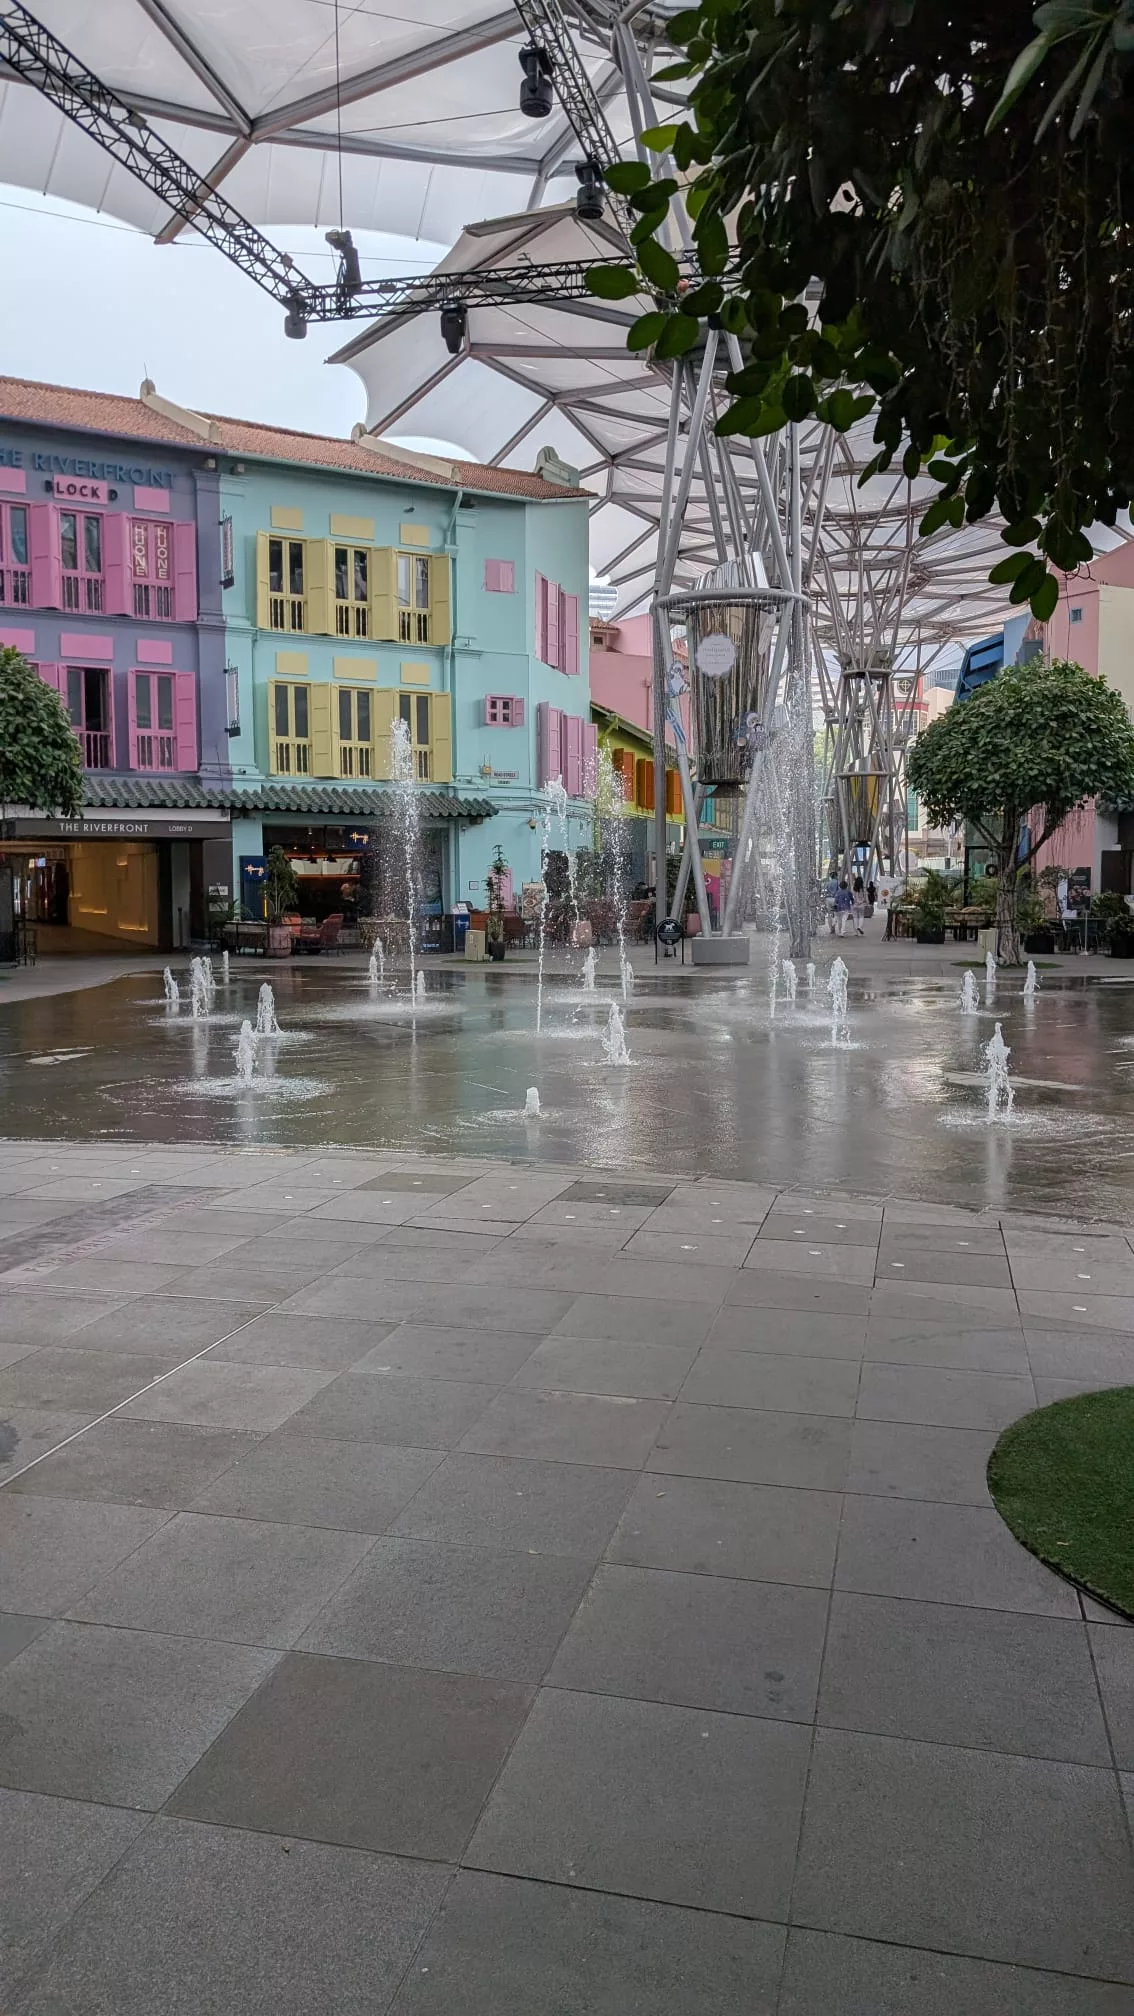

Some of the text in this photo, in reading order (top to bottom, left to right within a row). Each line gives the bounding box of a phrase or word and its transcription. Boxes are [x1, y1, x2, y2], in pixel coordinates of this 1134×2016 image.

[33, 453, 175, 489] RIVERFRONT
[45, 480, 119, 501] BLOCK D
[135, 525, 146, 576] HUONE
[157, 527, 168, 579] HUONE
[60, 823, 80, 832] THE
[83, 823, 149, 833] RIVERFRONT
[168, 825, 187, 833] LOBBY
